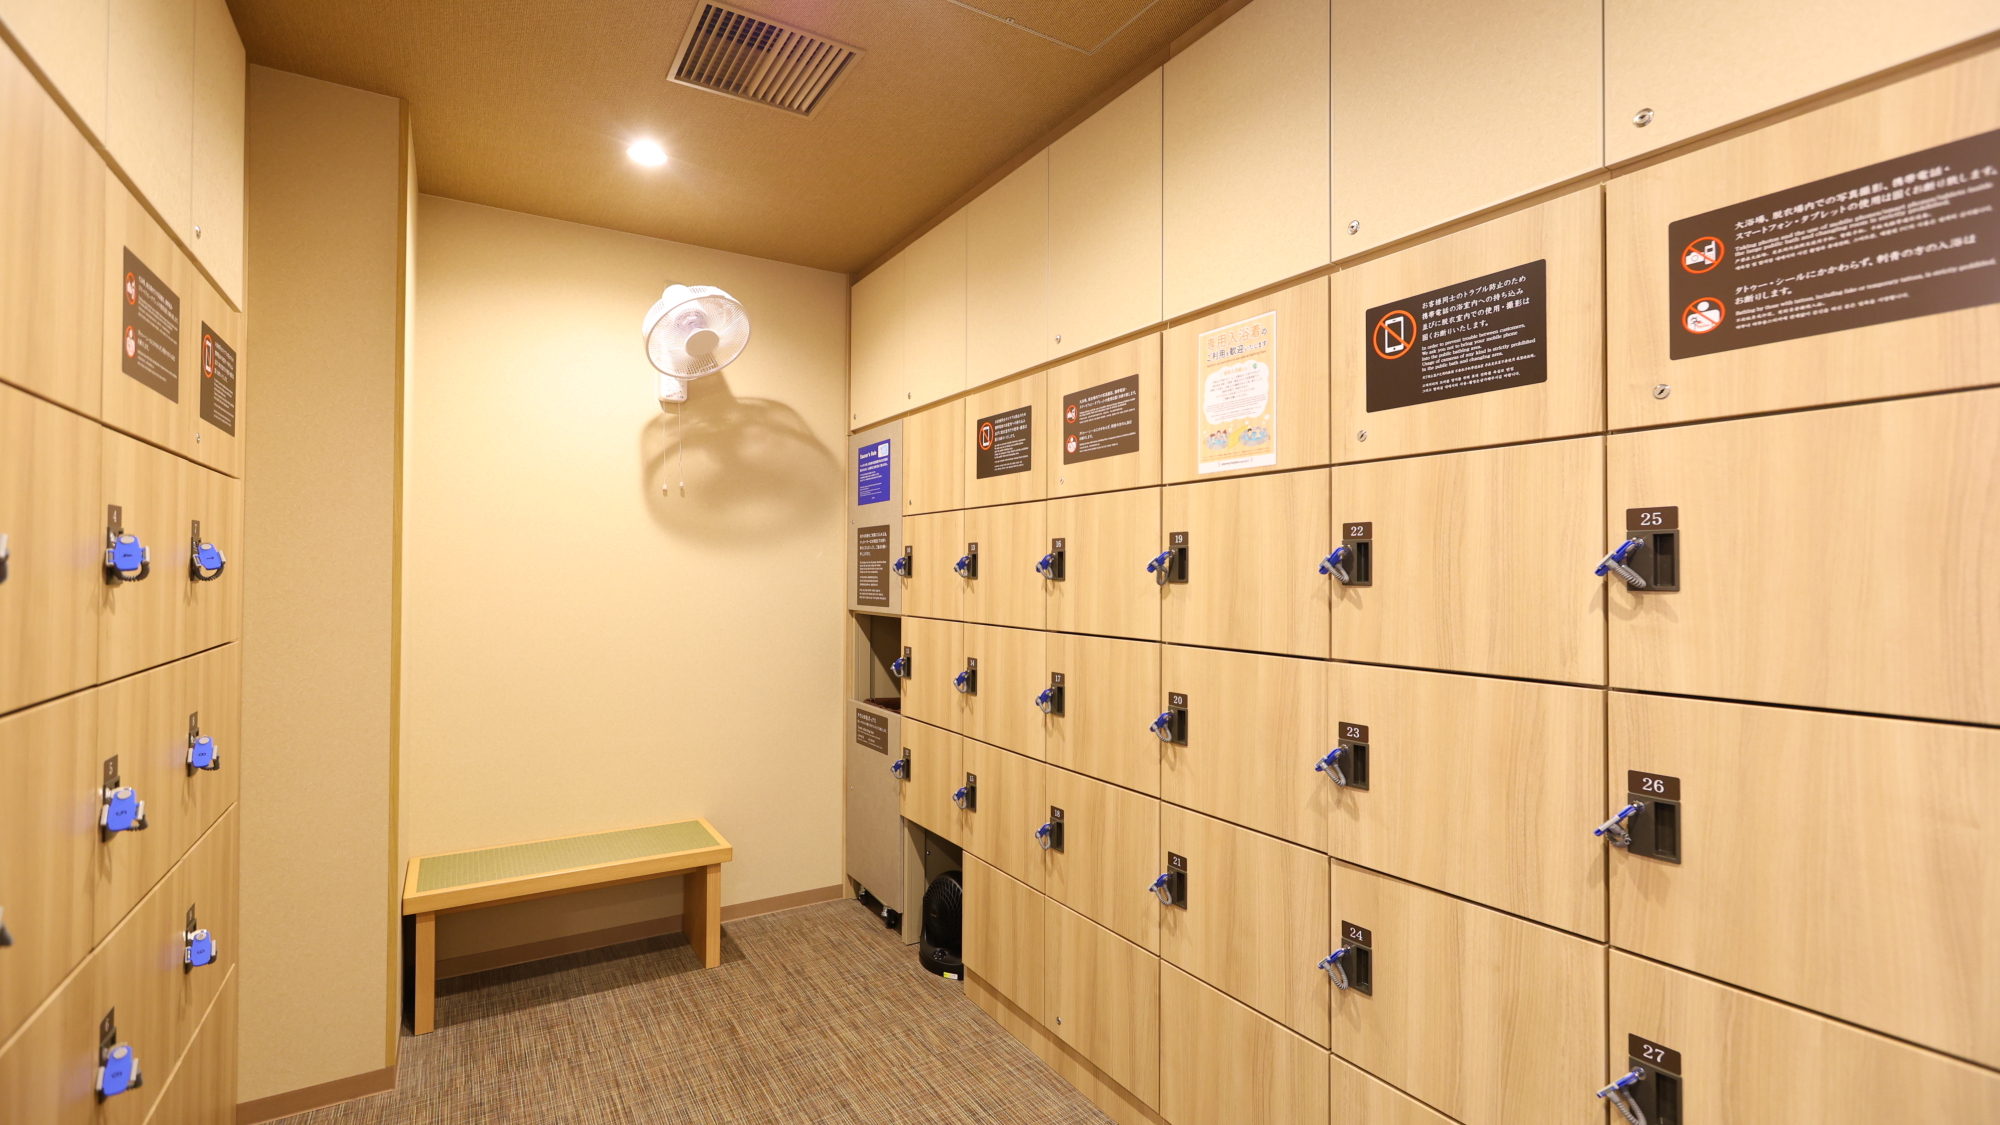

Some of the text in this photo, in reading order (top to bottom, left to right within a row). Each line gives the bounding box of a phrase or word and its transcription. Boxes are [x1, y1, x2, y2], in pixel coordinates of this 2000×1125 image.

[1422, 275, 1526, 309] お客様同士のトラブル防止のため
[1735, 287, 1792, 305] お断りします。
[1422, 288, 1524, 320] 携帯電話の浴室内への持ち込み
[1422, 297, 1530, 331] 並びに脱衣室内での使用・撮影は
[1206, 323, 1267, 351] 専用入浴着の
[1422, 320, 1488, 341] 固くお断りいたします。
[1445, 337, 1460, 346] prevent
[1462, 334, 1477, 342] trouble
[1479, 329, 1498, 338] between
[1461, 340, 1472, 348] bring
[1474, 337, 1484, 345] your
[1486, 333, 1501, 342] mobile
[1503, 329, 1517, 338] phone
[1206, 340, 1267, 362] ご利用を歓迎いたします
[1453, 346, 1469, 354] bathing
[1492, 343, 1509, 352] strictly
[1469, 353, 1490, 362] changing
[1640, 512, 1663, 526] 25
[1350, 526, 1364, 537] 22
[1174, 535, 1184, 544] 19
[970, 659, 975, 667] 14
[1055, 675, 1061, 683] 17
[1173, 695, 1183, 704] 20
[1346, 726, 1360, 739] 23
[108, 762, 113, 775] 5
[969, 774, 975, 782] 15
[1642, 778, 1665, 793] 26
[1054, 809, 1061, 817] 18
[1172, 855, 1181, 866] 21
[1349, 927, 1363, 941] 24
[1643, 1044, 1666, 1062] 27
